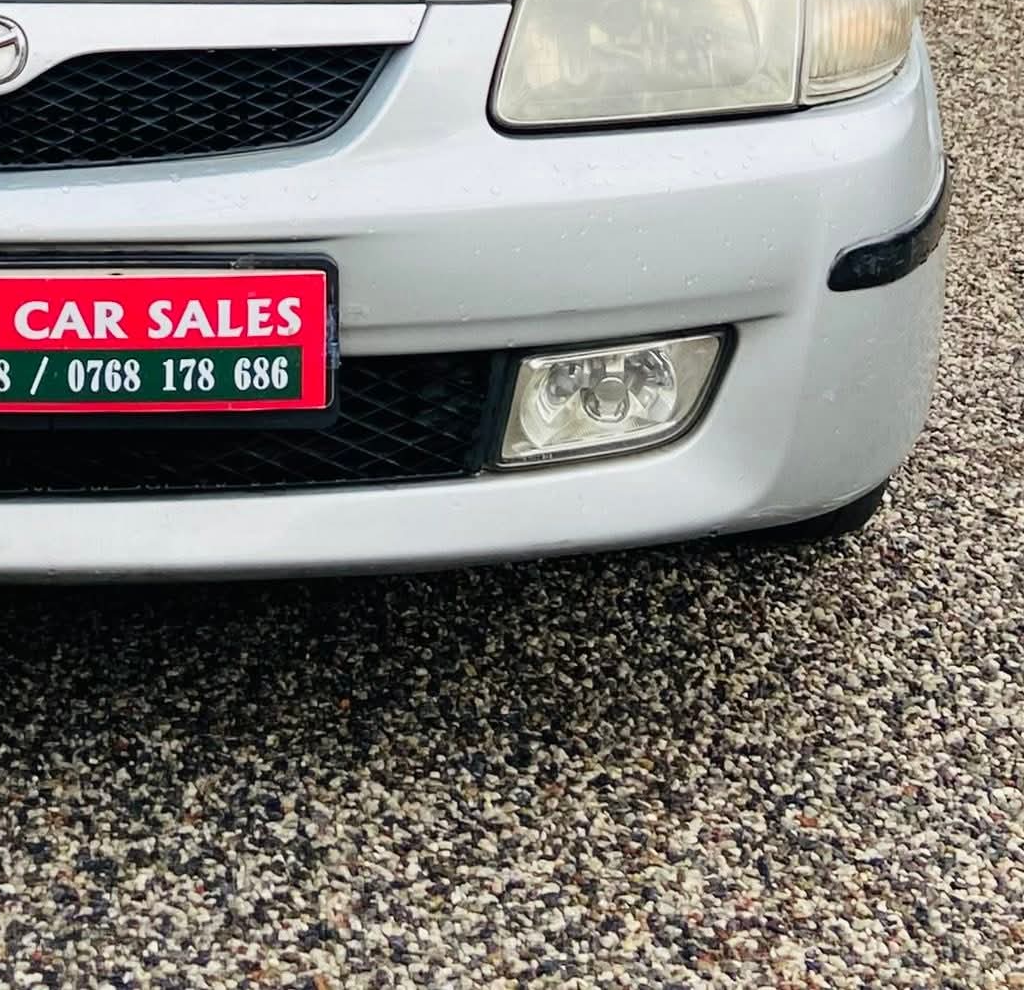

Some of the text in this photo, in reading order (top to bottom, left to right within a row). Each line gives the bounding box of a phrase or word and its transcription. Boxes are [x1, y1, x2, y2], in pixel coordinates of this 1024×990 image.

[14, 300, 128, 339] CAR
[147, 297, 302, 339] SALES
[30, 356, 49, 395] /
[67, 358, 141, 392] 0768
[162, 357, 215, 391] 178
[234, 356, 289, 390] 686
